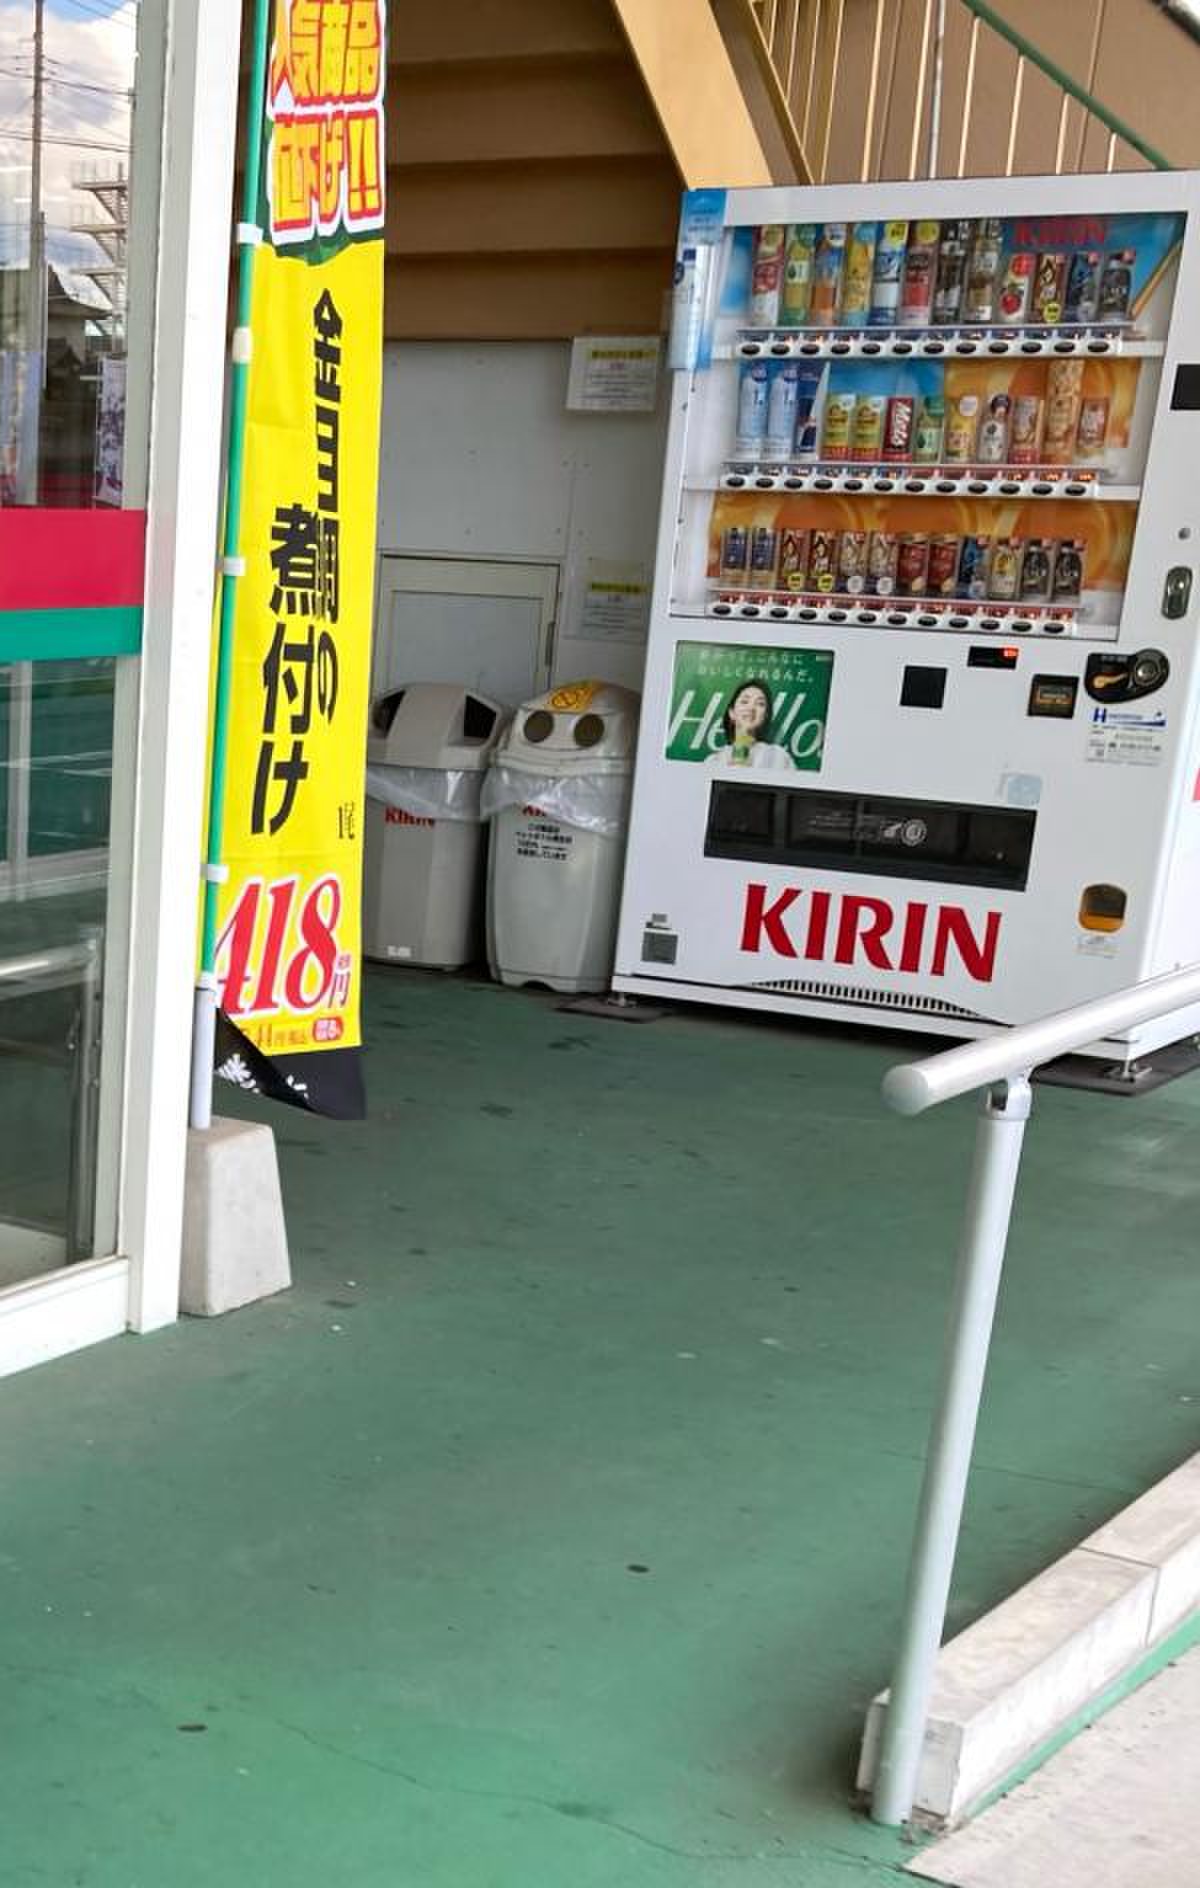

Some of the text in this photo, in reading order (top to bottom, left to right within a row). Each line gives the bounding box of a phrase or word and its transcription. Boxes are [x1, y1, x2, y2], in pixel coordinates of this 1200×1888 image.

[250, 503, 317, 837] 煮付け
[215, 878, 341, 1015] 418
[740, 883, 1003, 983] KIRIN
